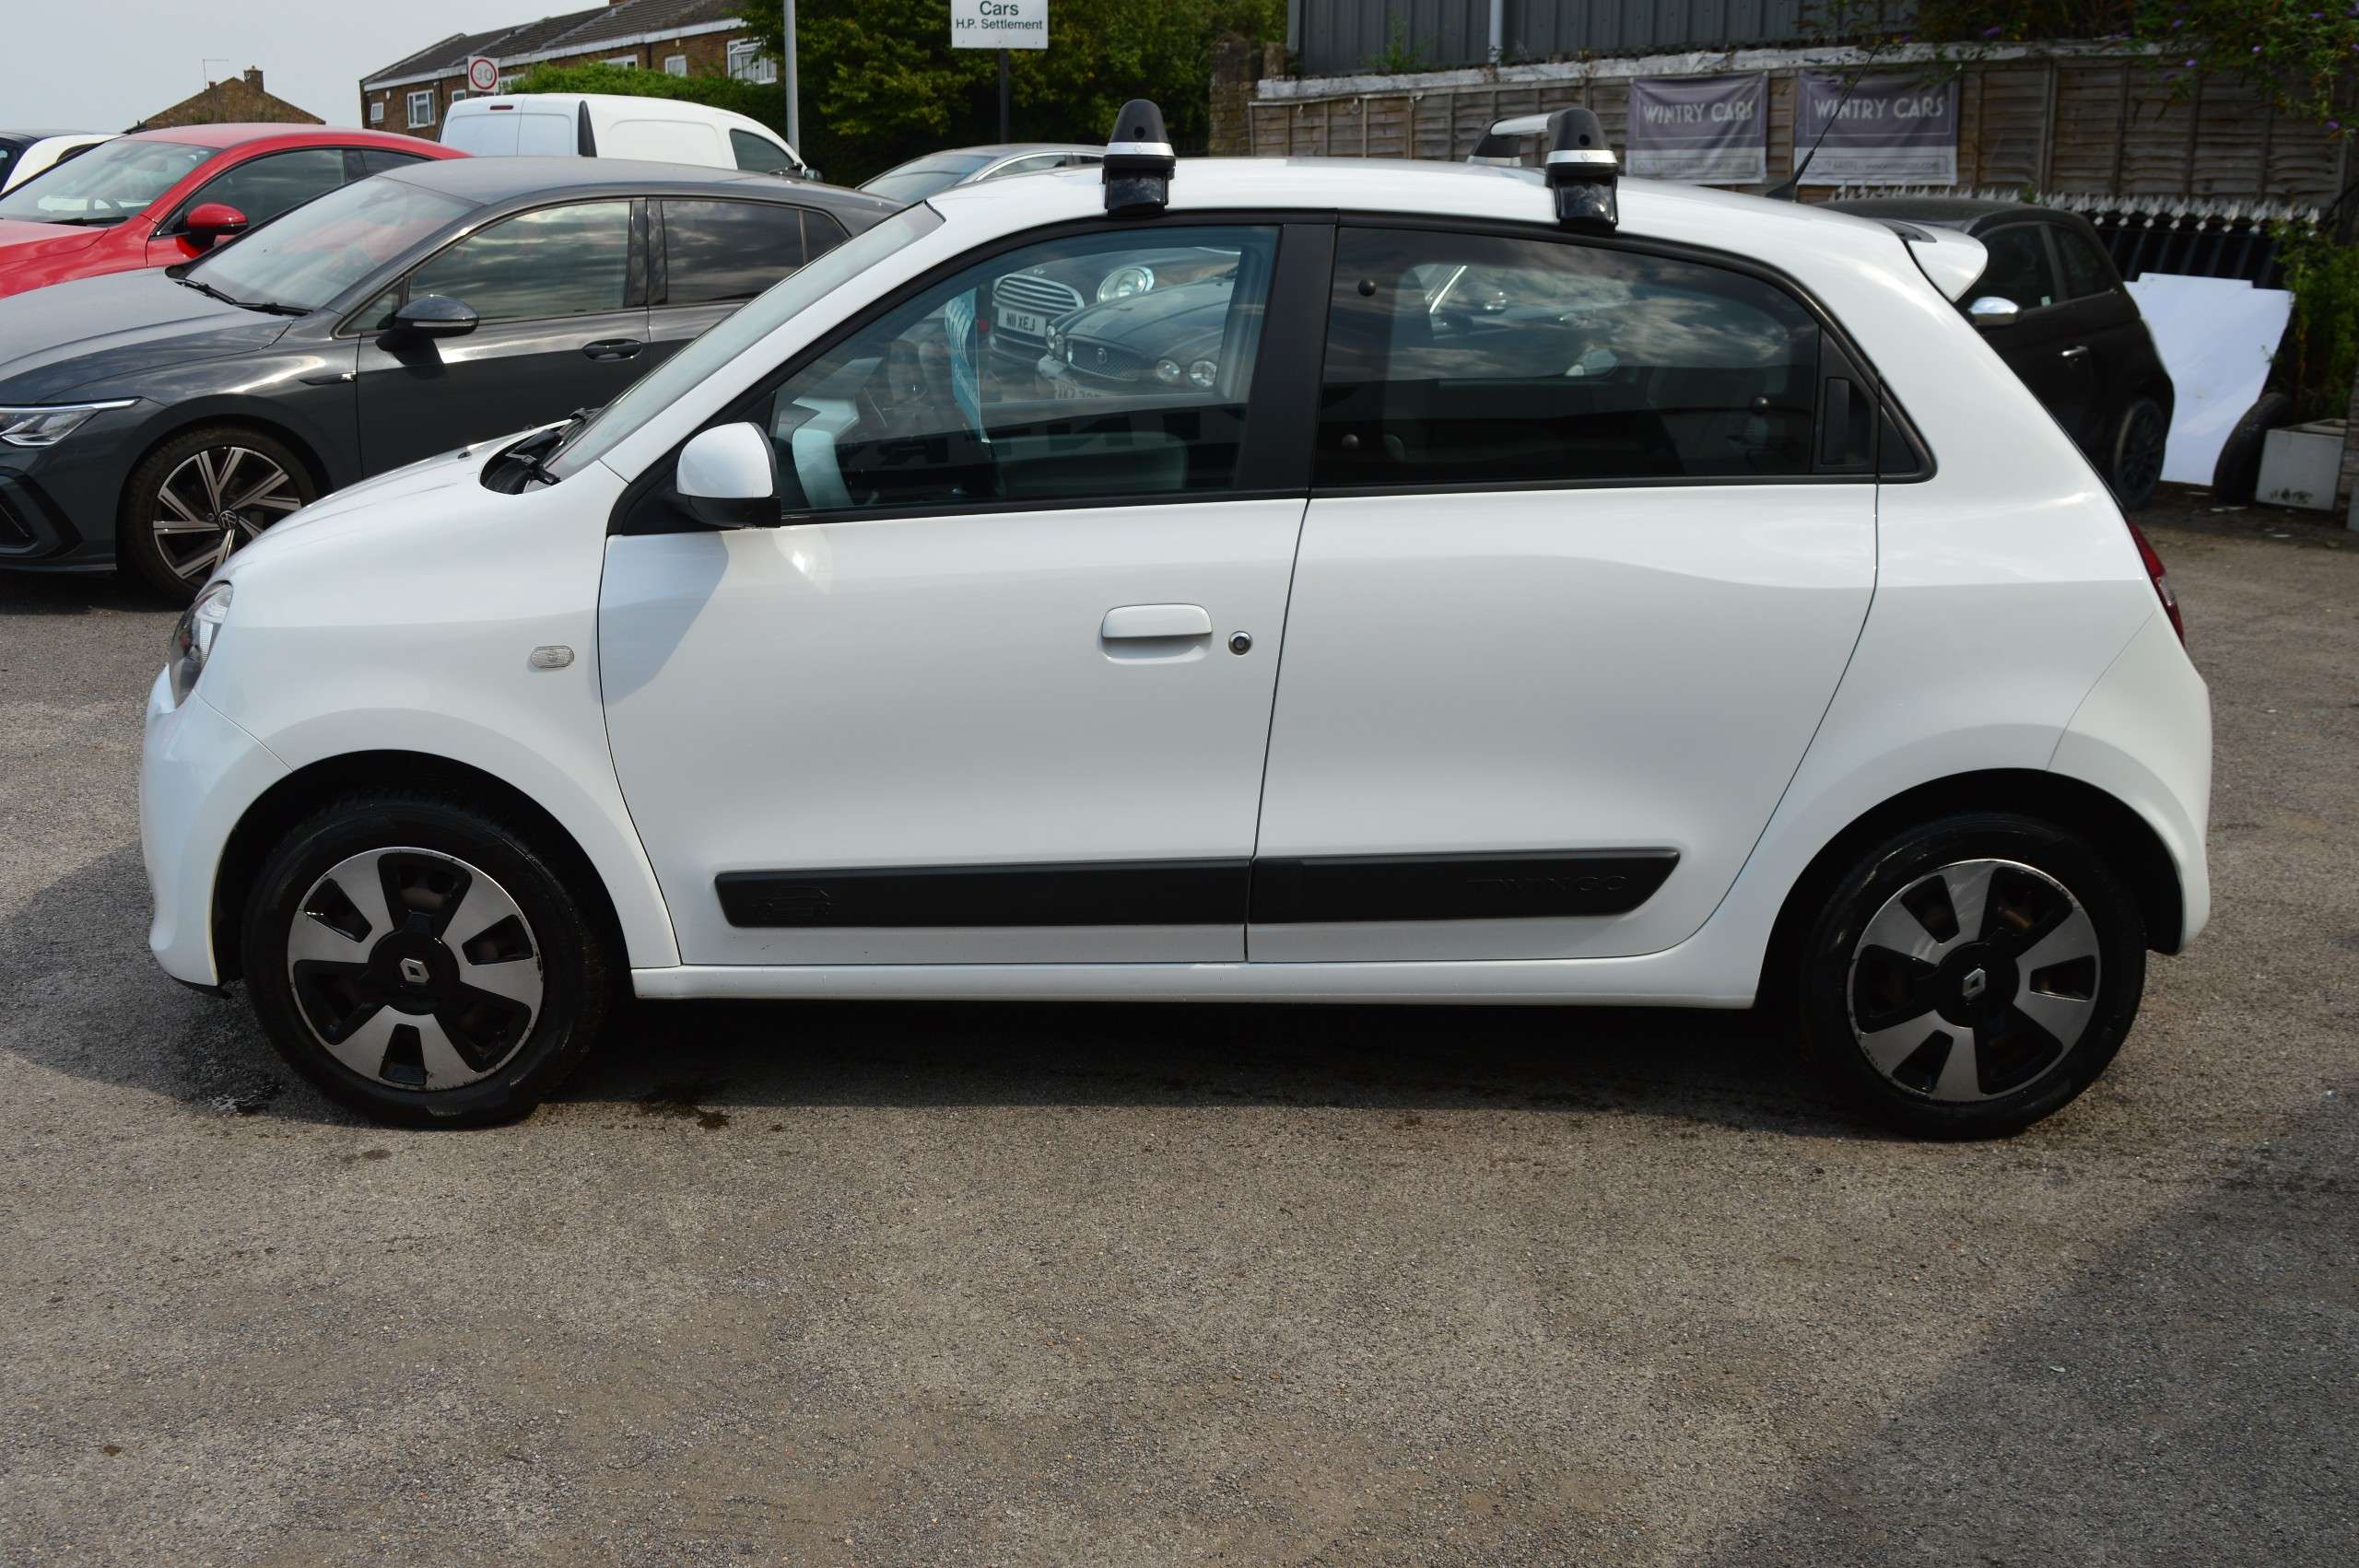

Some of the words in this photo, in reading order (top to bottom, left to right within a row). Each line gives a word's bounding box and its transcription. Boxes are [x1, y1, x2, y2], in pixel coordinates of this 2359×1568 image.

[980, 0, 1019, 16] Cars
[956, 18, 977, 29] H.P.
[980, 18, 1043, 29] Settlement
[1643, 103, 1705, 125] WINTRY
[1710, 100, 1755, 123] CARS
[1813, 98, 1888, 119] WINTRY
[1893, 96, 1944, 119] CARS
